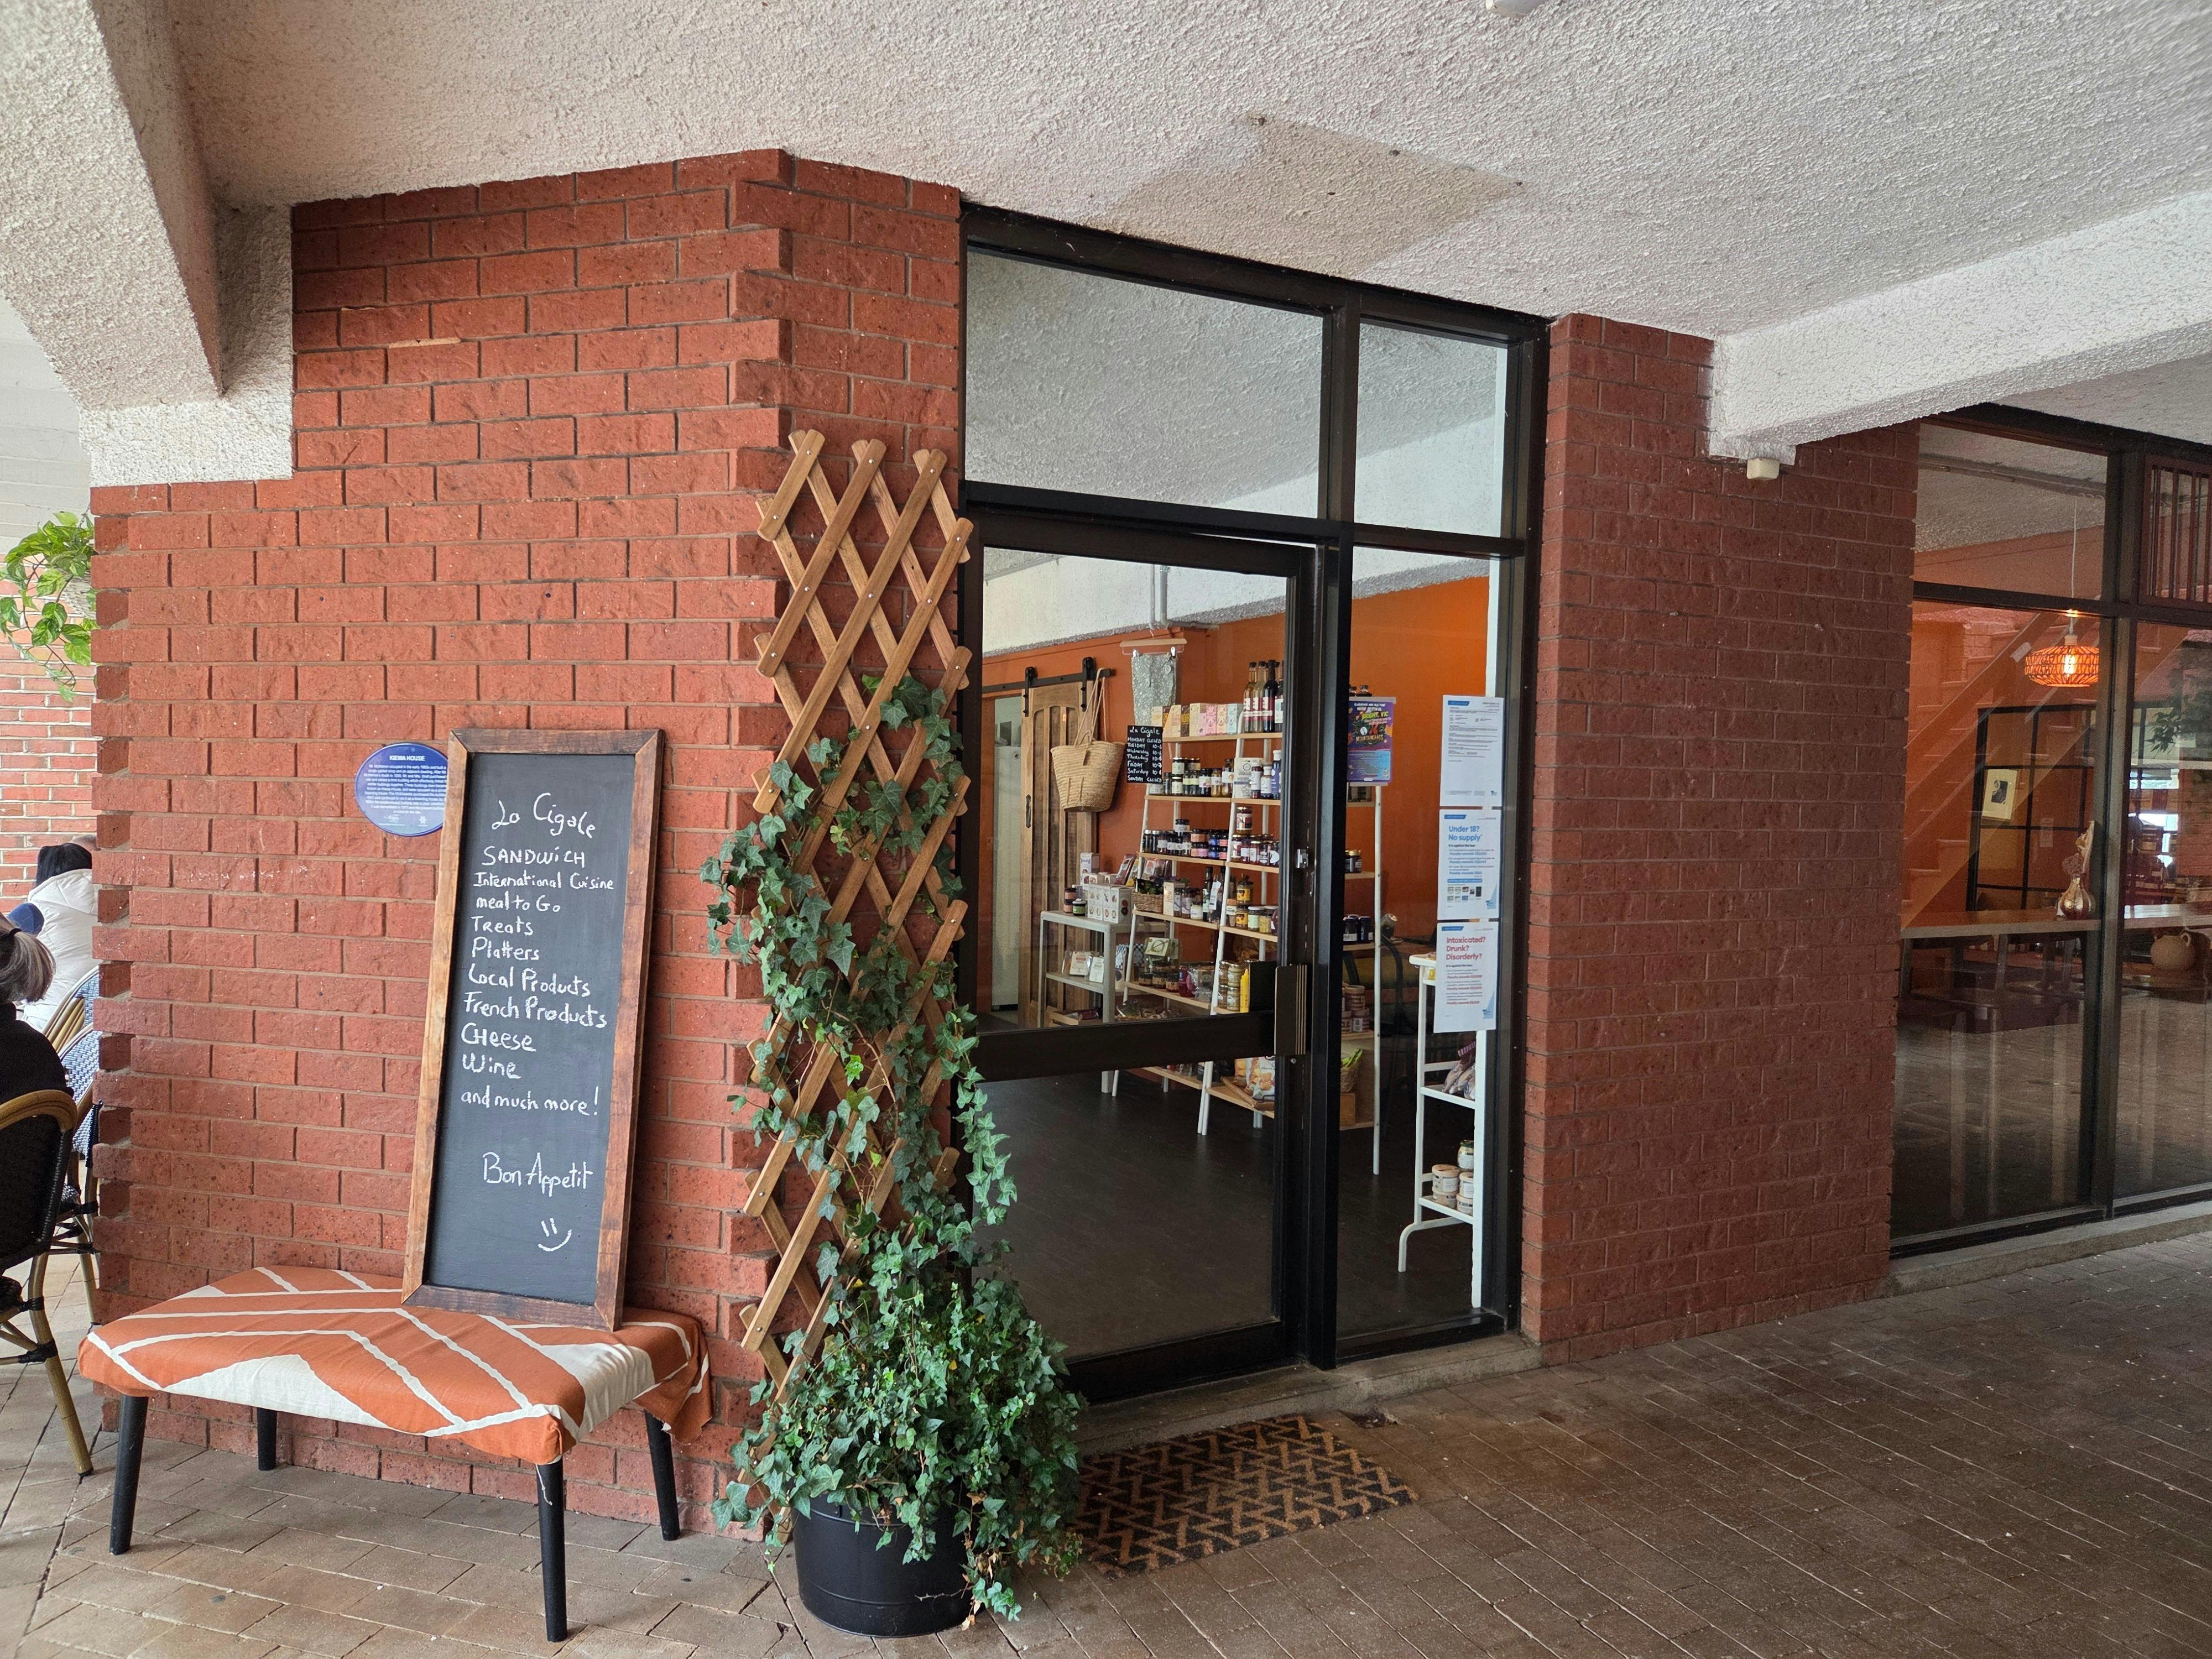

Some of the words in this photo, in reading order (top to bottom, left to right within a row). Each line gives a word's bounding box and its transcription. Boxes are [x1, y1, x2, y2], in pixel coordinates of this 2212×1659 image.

[1140, 727, 1160, 738] Cigale
[533, 792, 596, 839] Cigale
[472, 869, 562, 888] International
[569, 872, 615, 890] Cuisine
[476, 890, 510, 910] meal
[511, 894, 530, 911] to
[535, 894, 561, 912] Go
[471, 915, 534, 936] Treats
[471, 936, 540, 961] Platters
[1446, 952, 1482, 961] Disorderly?
[468, 963, 514, 989] Local
[521, 967, 591, 998] Products
[463, 991, 520, 1019] French
[525, 995, 607, 1029] Products
[462, 1052, 522, 1079] Wine
[461, 1085, 491, 1108] and
[494, 1090, 539, 1111] much
[482, 1151, 522, 1186] Bon
[525, 1152, 593, 1198] Appetit
